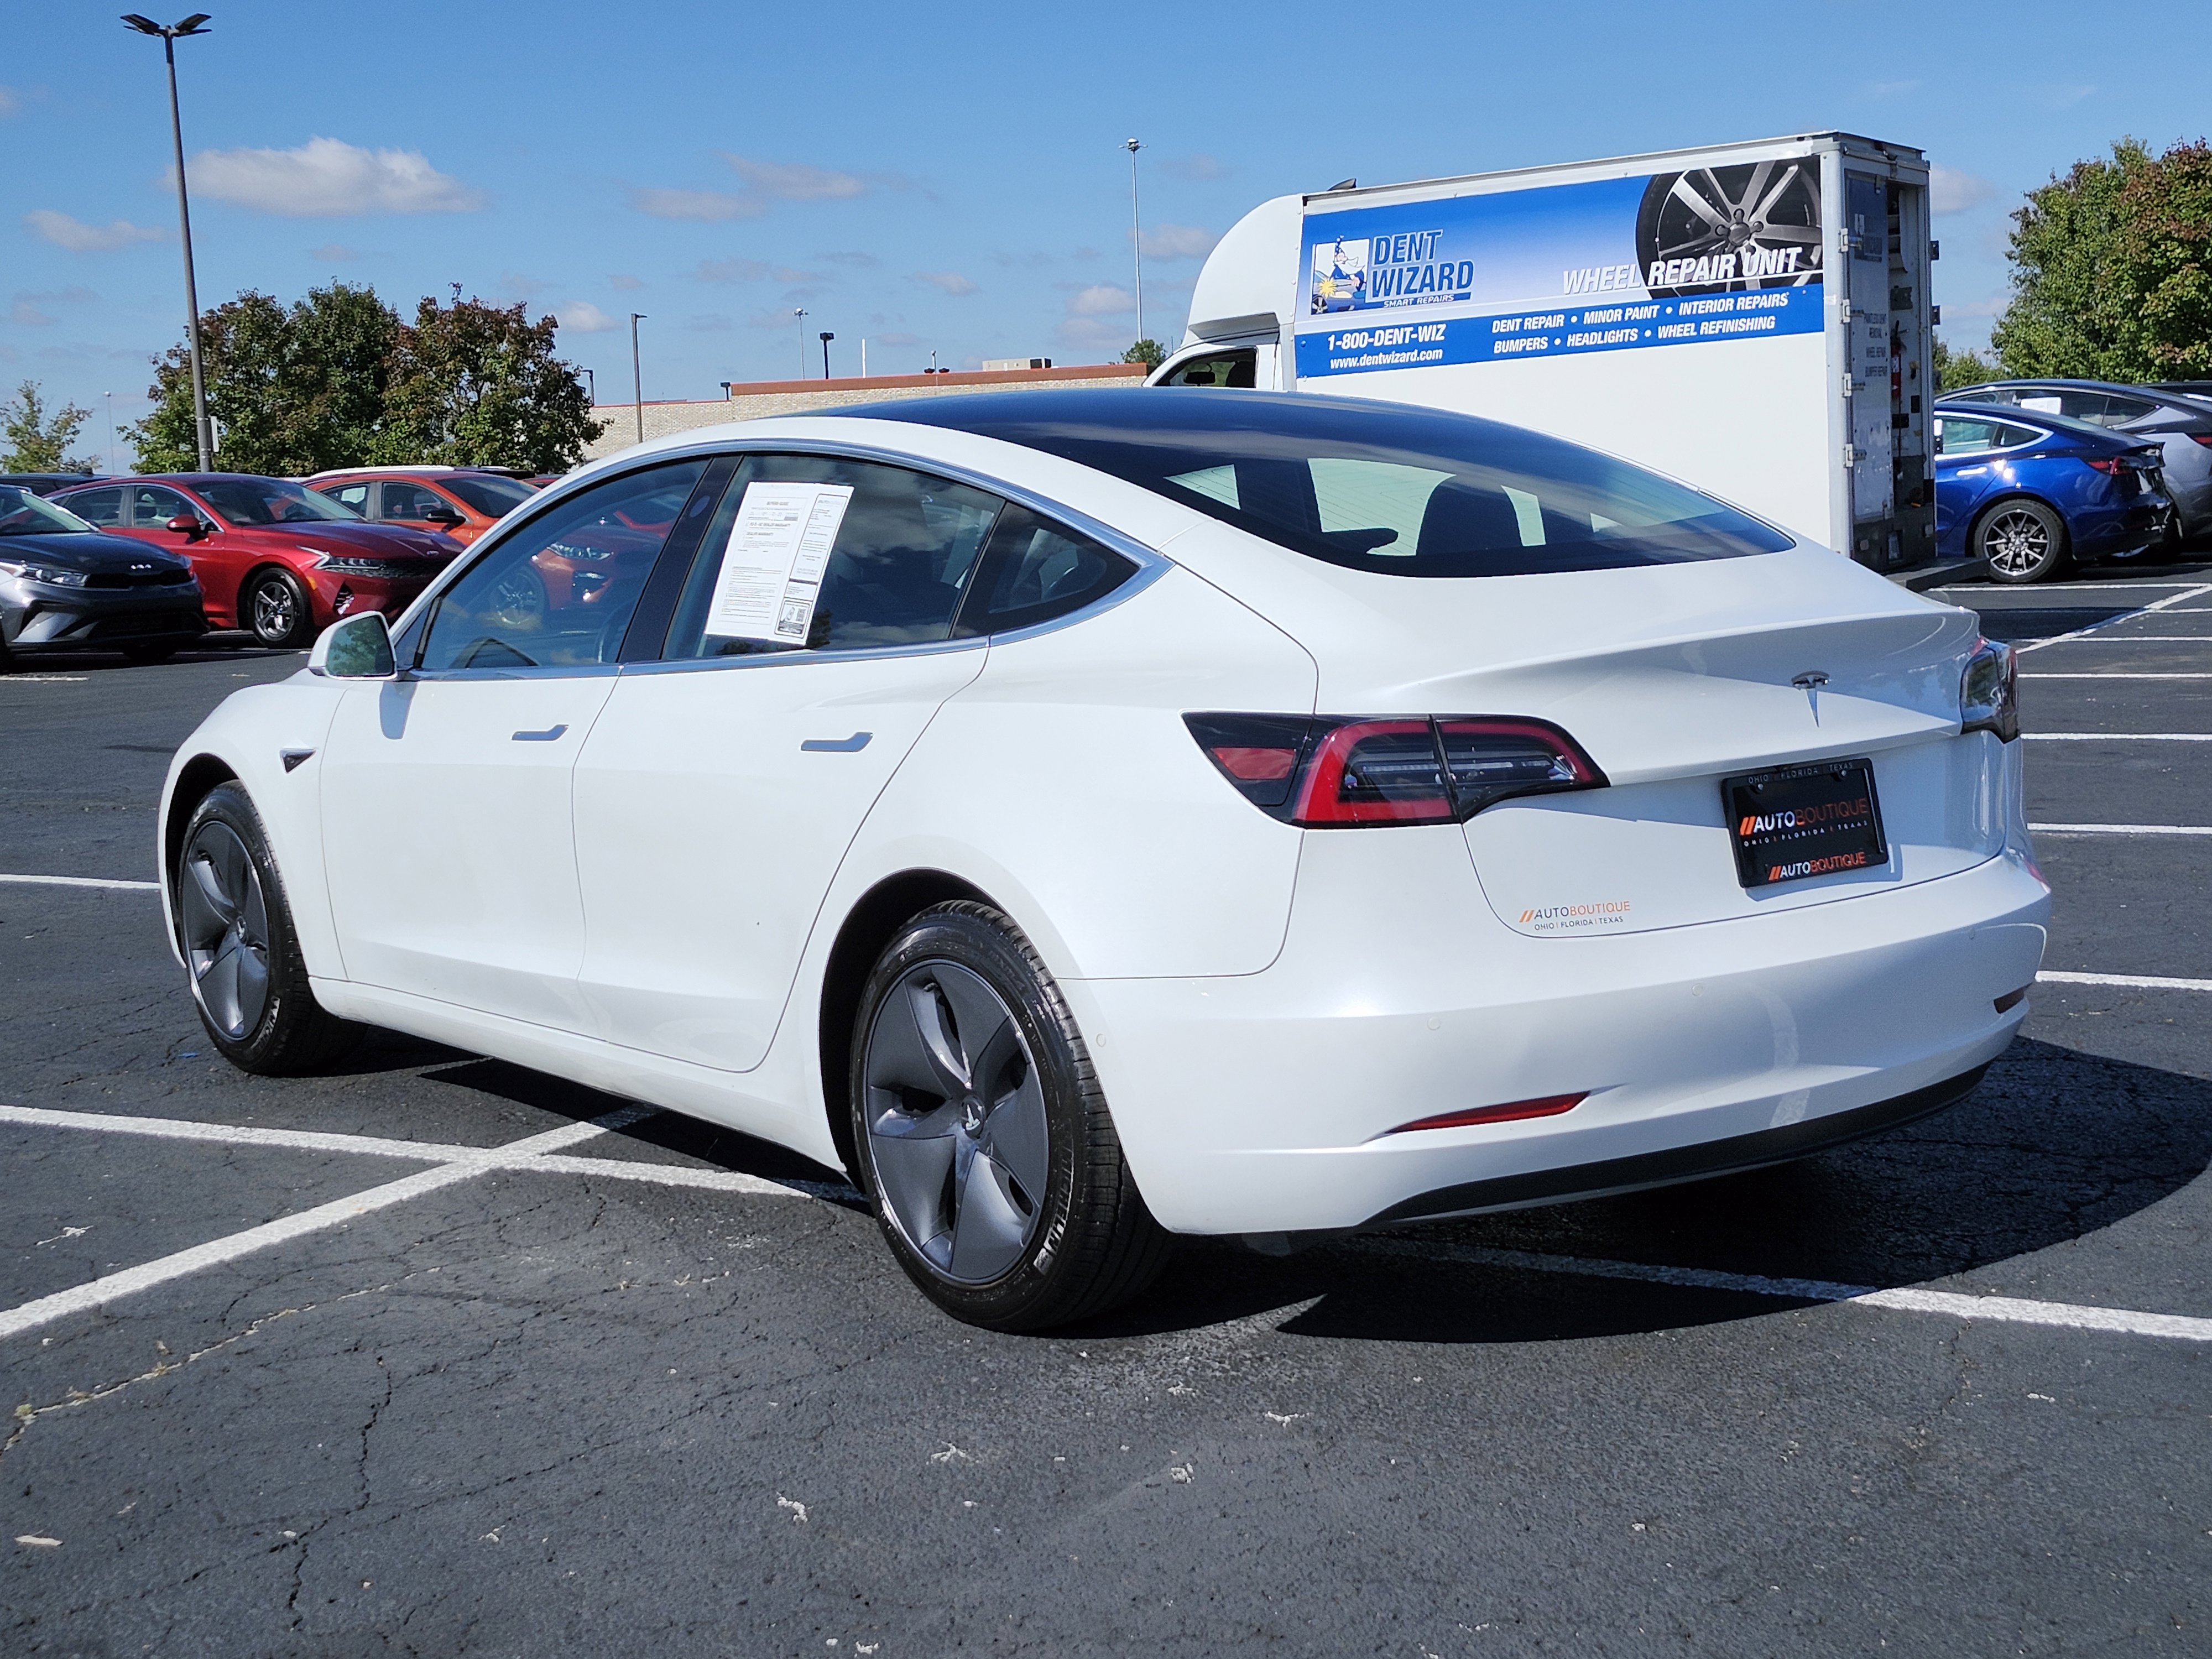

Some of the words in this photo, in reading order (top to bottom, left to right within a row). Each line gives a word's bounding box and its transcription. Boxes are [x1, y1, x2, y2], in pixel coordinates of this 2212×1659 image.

[1374, 230, 1442, 265] DENT
[1371, 261, 1474, 298] WIZARD
[1563, 264, 1641, 295] WHEEL
[1648, 254, 1736, 286] REPAIR
[1742, 247, 1803, 278] UNIT
[1384, 298, 1415, 308] SMART
[1417, 294, 1454, 304] REPAIRS
[1493, 319, 1522, 333] DENT
[1524, 314, 1564, 328] REPAIR
[1583, 309, 1623, 325] MINOR
[1624, 305, 1660, 321] PAINT
[1678, 299, 1734, 316] INTERIOR
[1736, 293, 1788, 311] REPAIRS
[1327, 324, 1447, 351] 1-800-DENT-WIZ
[1494, 337, 1548, 354] BUMPERS
[1567, 328, 1638, 347] HEADLIGHTS
[1658, 324, 1698, 340] WHEEL
[1699, 316, 1776, 335] REFINISHING
[1330, 348, 1443, 369] www.dentwizard.com
[1749, 774, 1768, 784] OHIO
[1829, 763, 1853, 771] TEXAS
[1753, 798, 1869, 833] AUTOBOUTIQUE
[1781, 827, 1825, 841] FLORIDA
[1780, 852, 1867, 878] AUTOBOUTIQUE
[1533, 901, 1631, 920] AUTOBOUTIQUE
[1534, 922, 1554, 931] OHIO
[1561, 919, 1593, 928] FLORIDA
[1599, 916, 1623, 925] TEXAS
